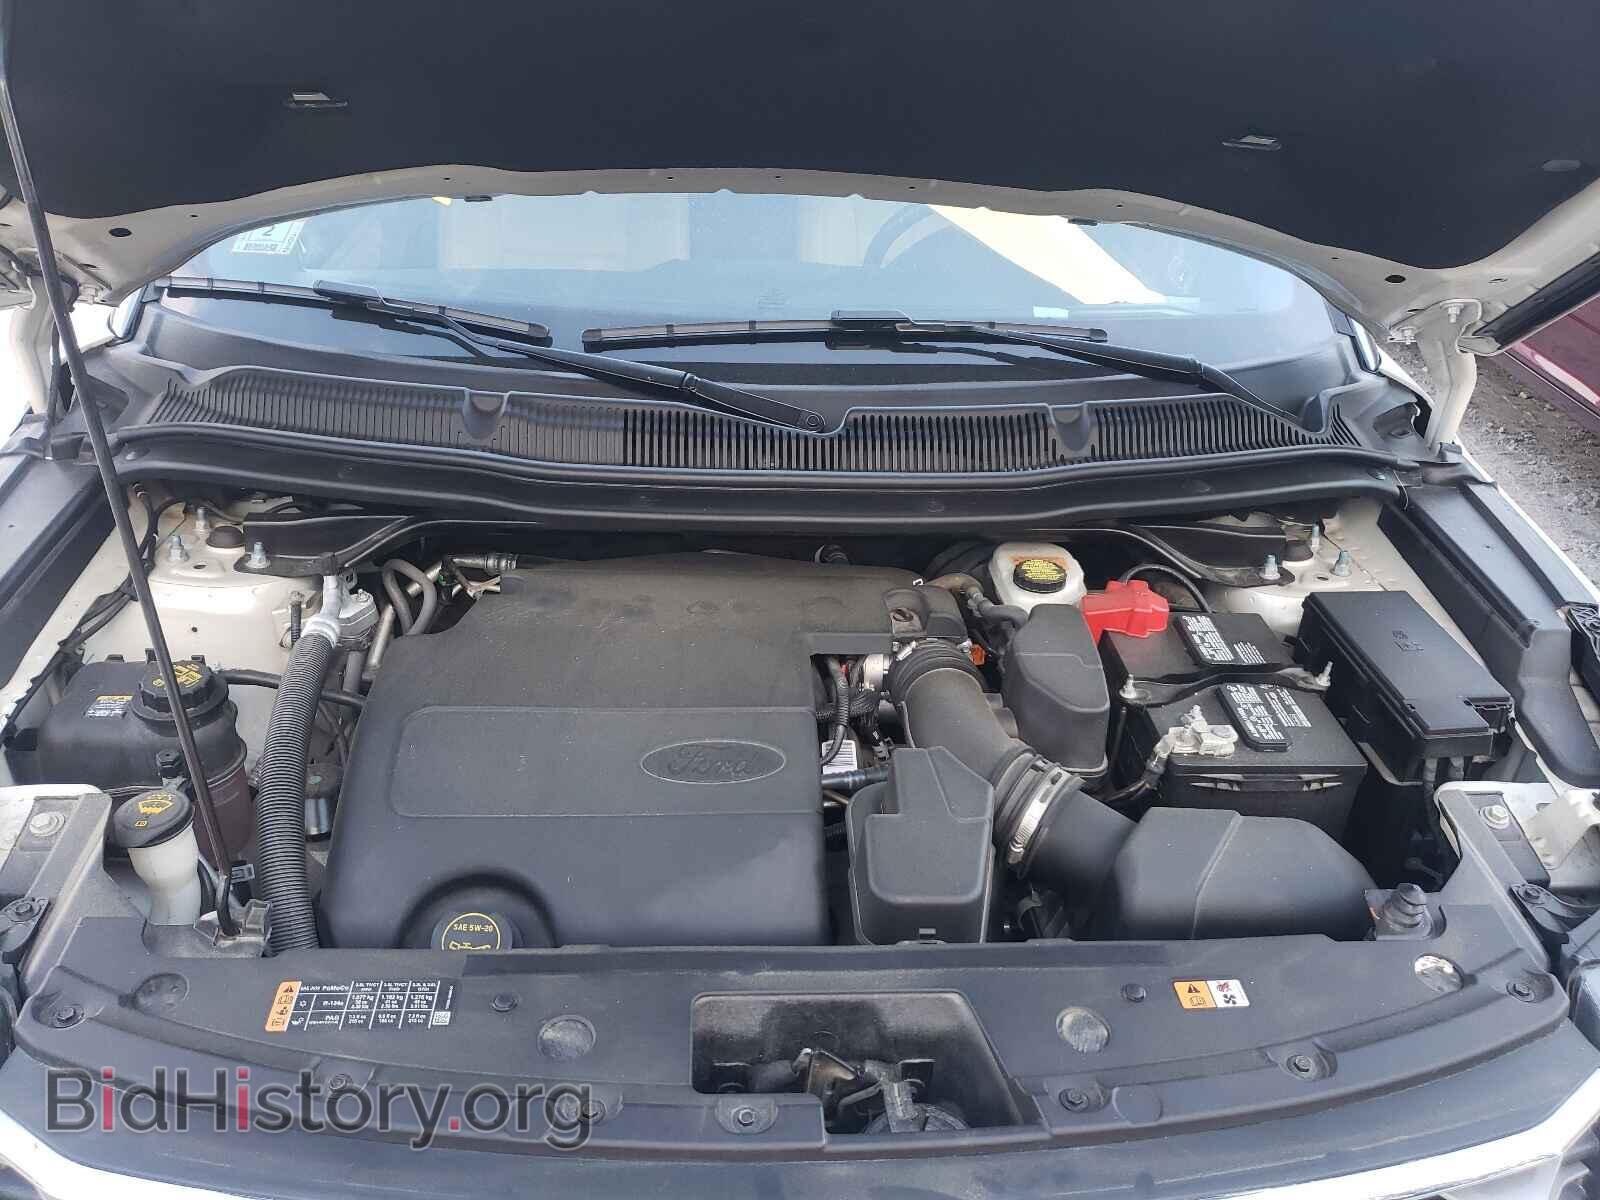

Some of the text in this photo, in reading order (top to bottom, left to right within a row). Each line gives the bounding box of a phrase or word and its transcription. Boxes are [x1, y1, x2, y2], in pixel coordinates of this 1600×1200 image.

[667, 746, 759, 776] Ford
[453, 923, 494, 933] SAE 5W-20
